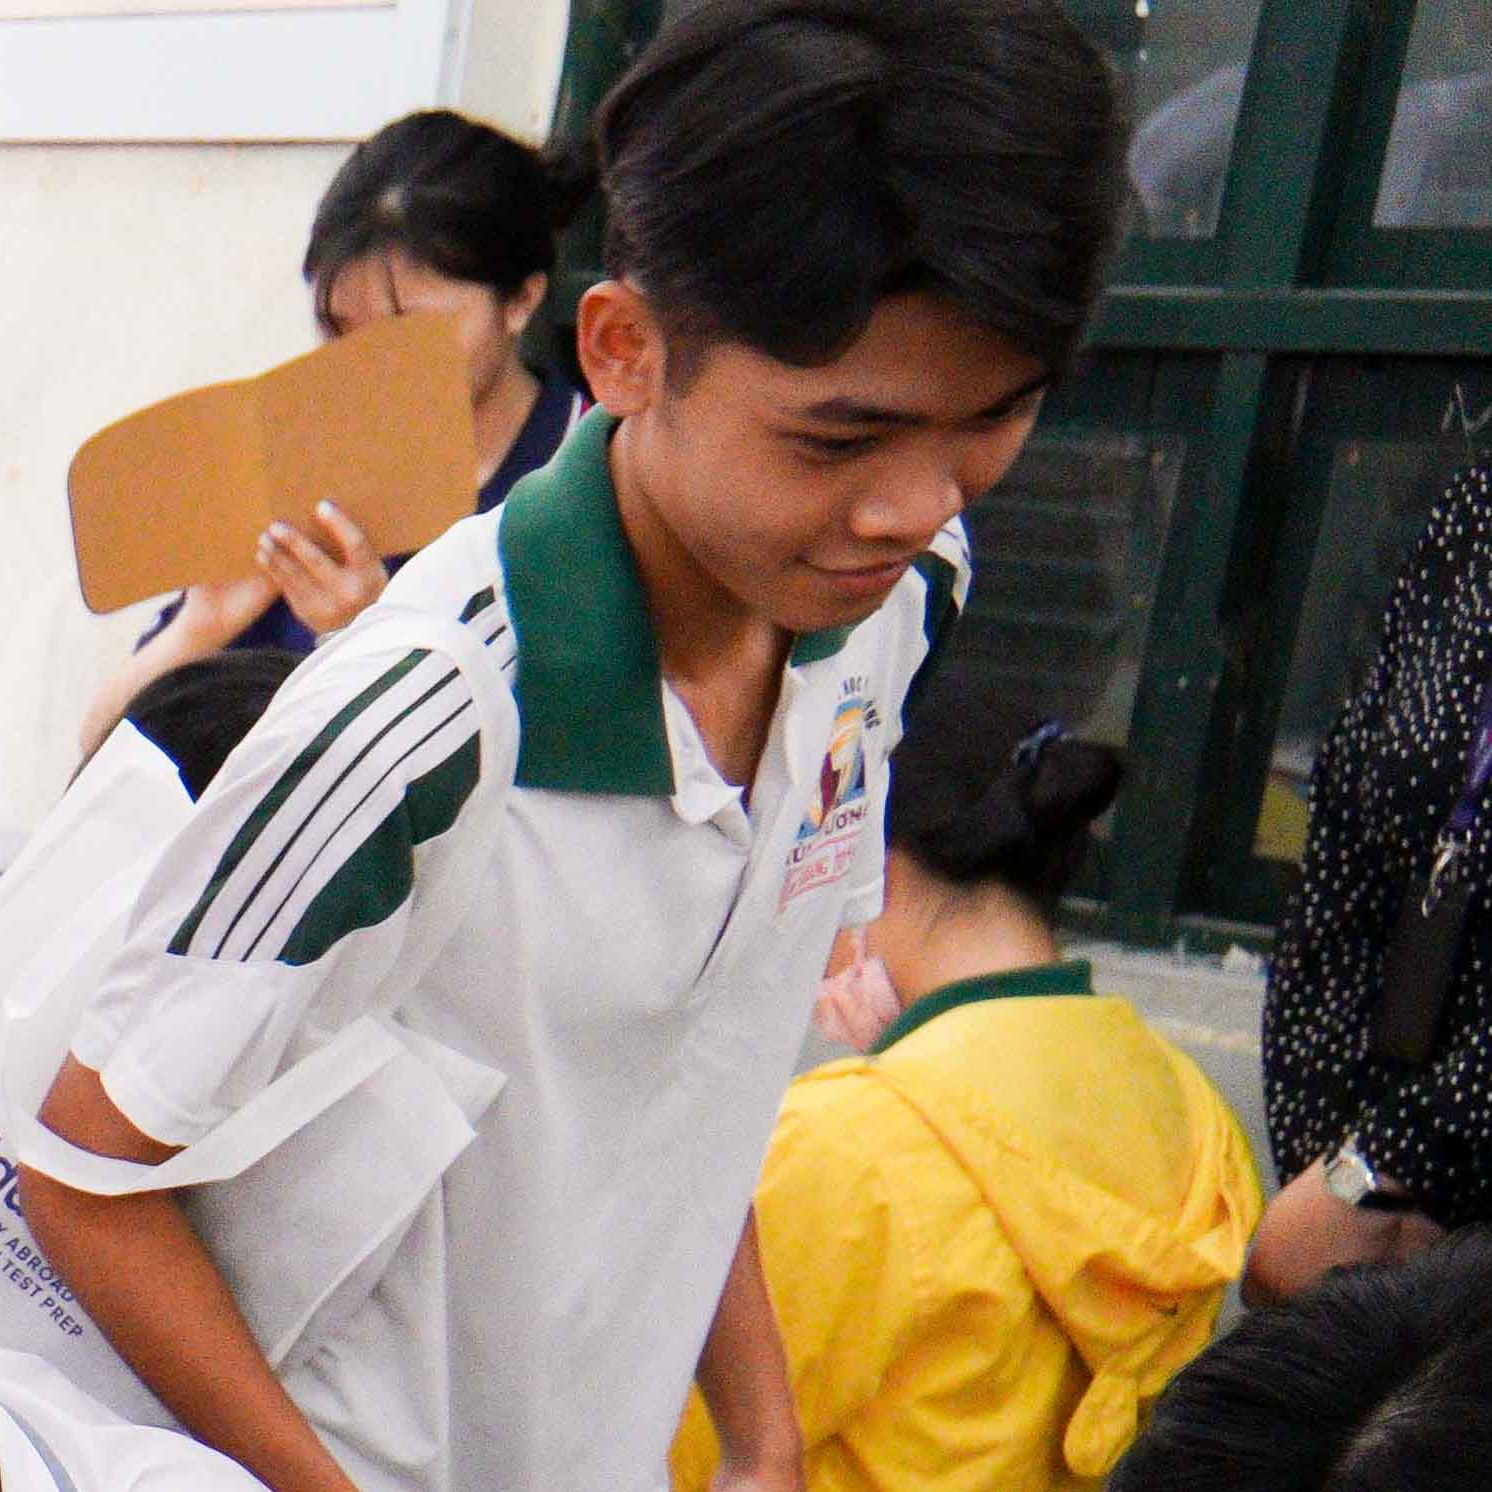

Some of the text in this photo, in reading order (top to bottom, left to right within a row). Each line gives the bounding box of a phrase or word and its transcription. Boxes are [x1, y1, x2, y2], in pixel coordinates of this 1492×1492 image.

[1, 1260, 43, 1297] TEST
[39, 1296, 84, 1337] PREP
[4, 1237, 75, 1302] ABROAD
